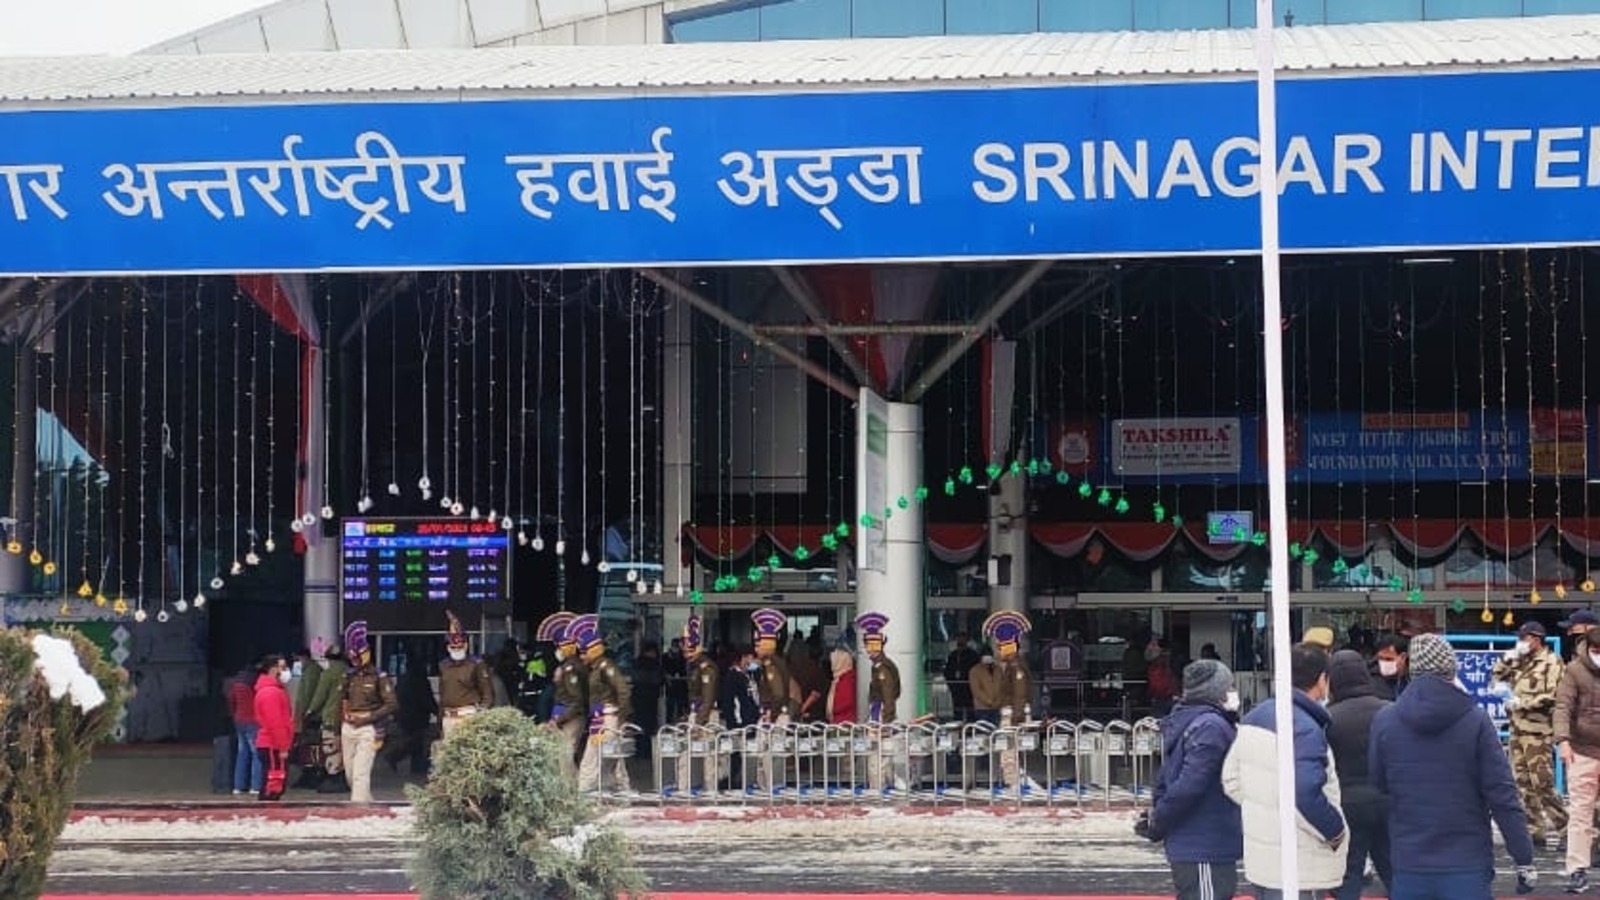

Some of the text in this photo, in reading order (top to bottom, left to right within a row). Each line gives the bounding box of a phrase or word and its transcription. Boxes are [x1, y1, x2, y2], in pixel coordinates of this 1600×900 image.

[103, 131, 466, 230] अन्तर्राष्ट्रीय
[506, 126, 676, 222] हवाई
[718, 146, 922, 229] अड्डा
[973, 126, 1600, 203] SRINAGAR INTE
[1122, 428, 1230, 443] TAKSHILA
[1312, 454, 1400, 470] FOUNDATION
